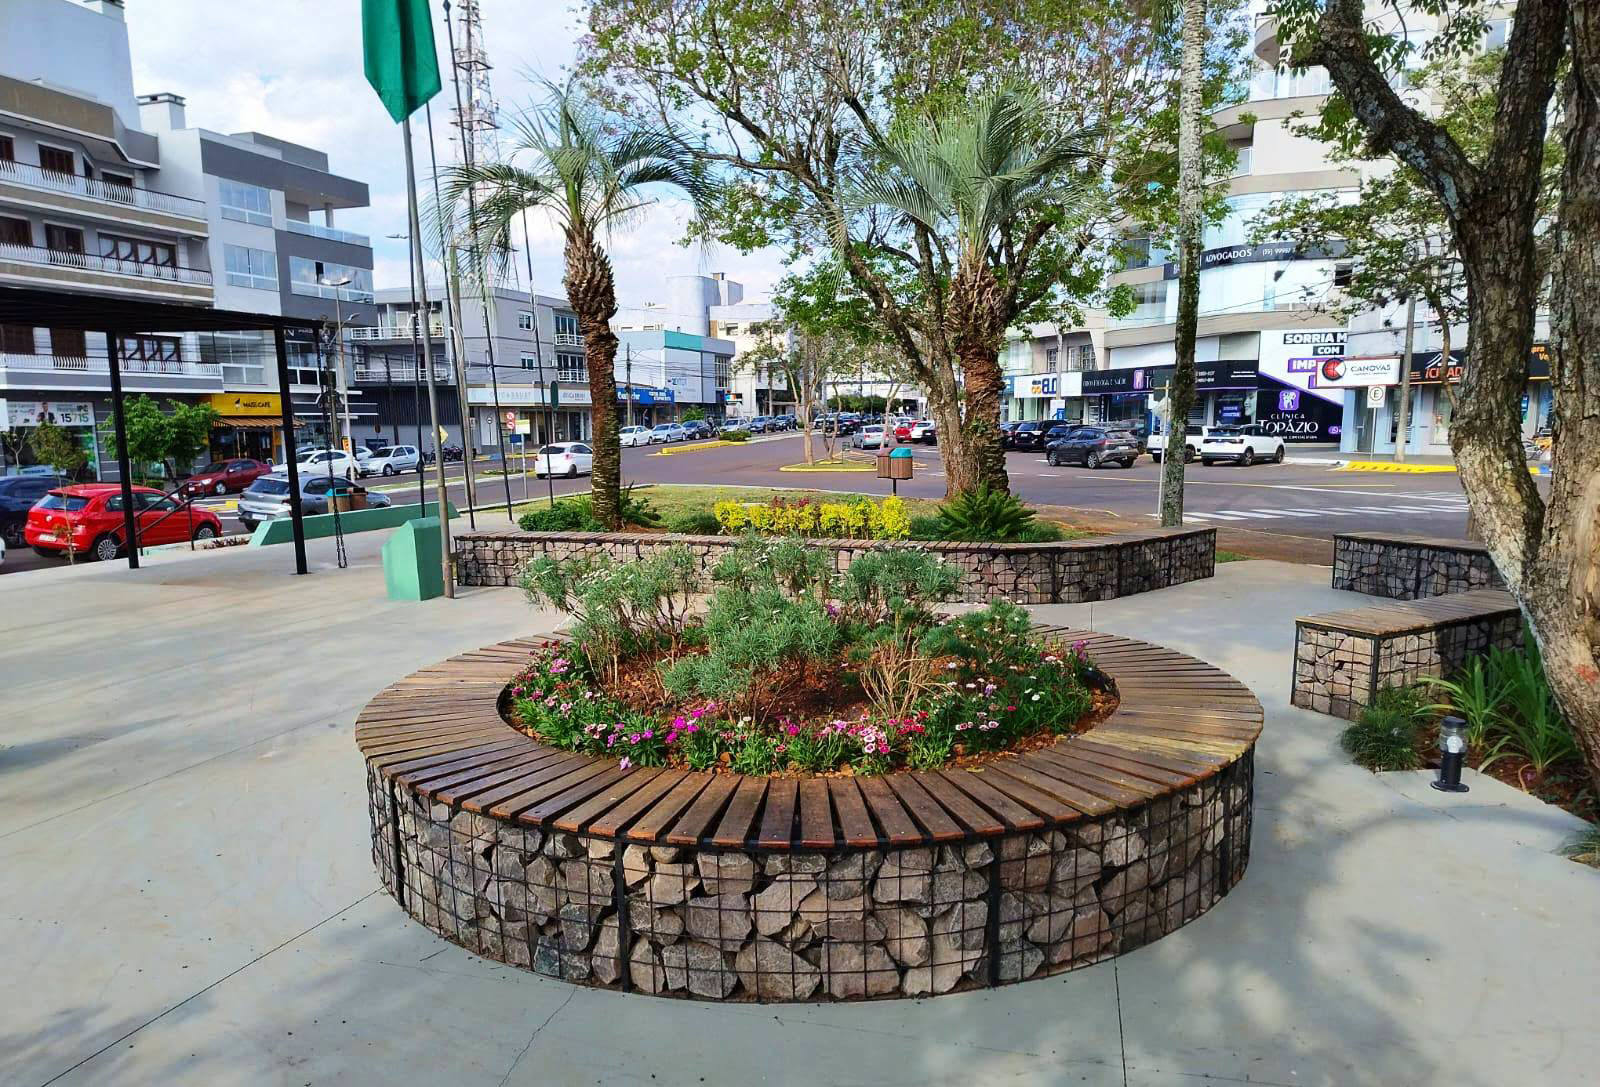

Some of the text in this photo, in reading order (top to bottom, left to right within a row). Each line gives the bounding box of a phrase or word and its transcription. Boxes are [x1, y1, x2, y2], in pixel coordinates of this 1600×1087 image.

[1205, 248, 1253, 262] ADVOGADOS
[1285, 333, 1334, 344] SORRIA
[1350, 364, 1391, 373] CANOVAS
[1372, 389, 1379, 399] E
[1270, 411, 1306, 420] CLÍNICA
[1257, 418, 1319, 434] TOPÁZIO
